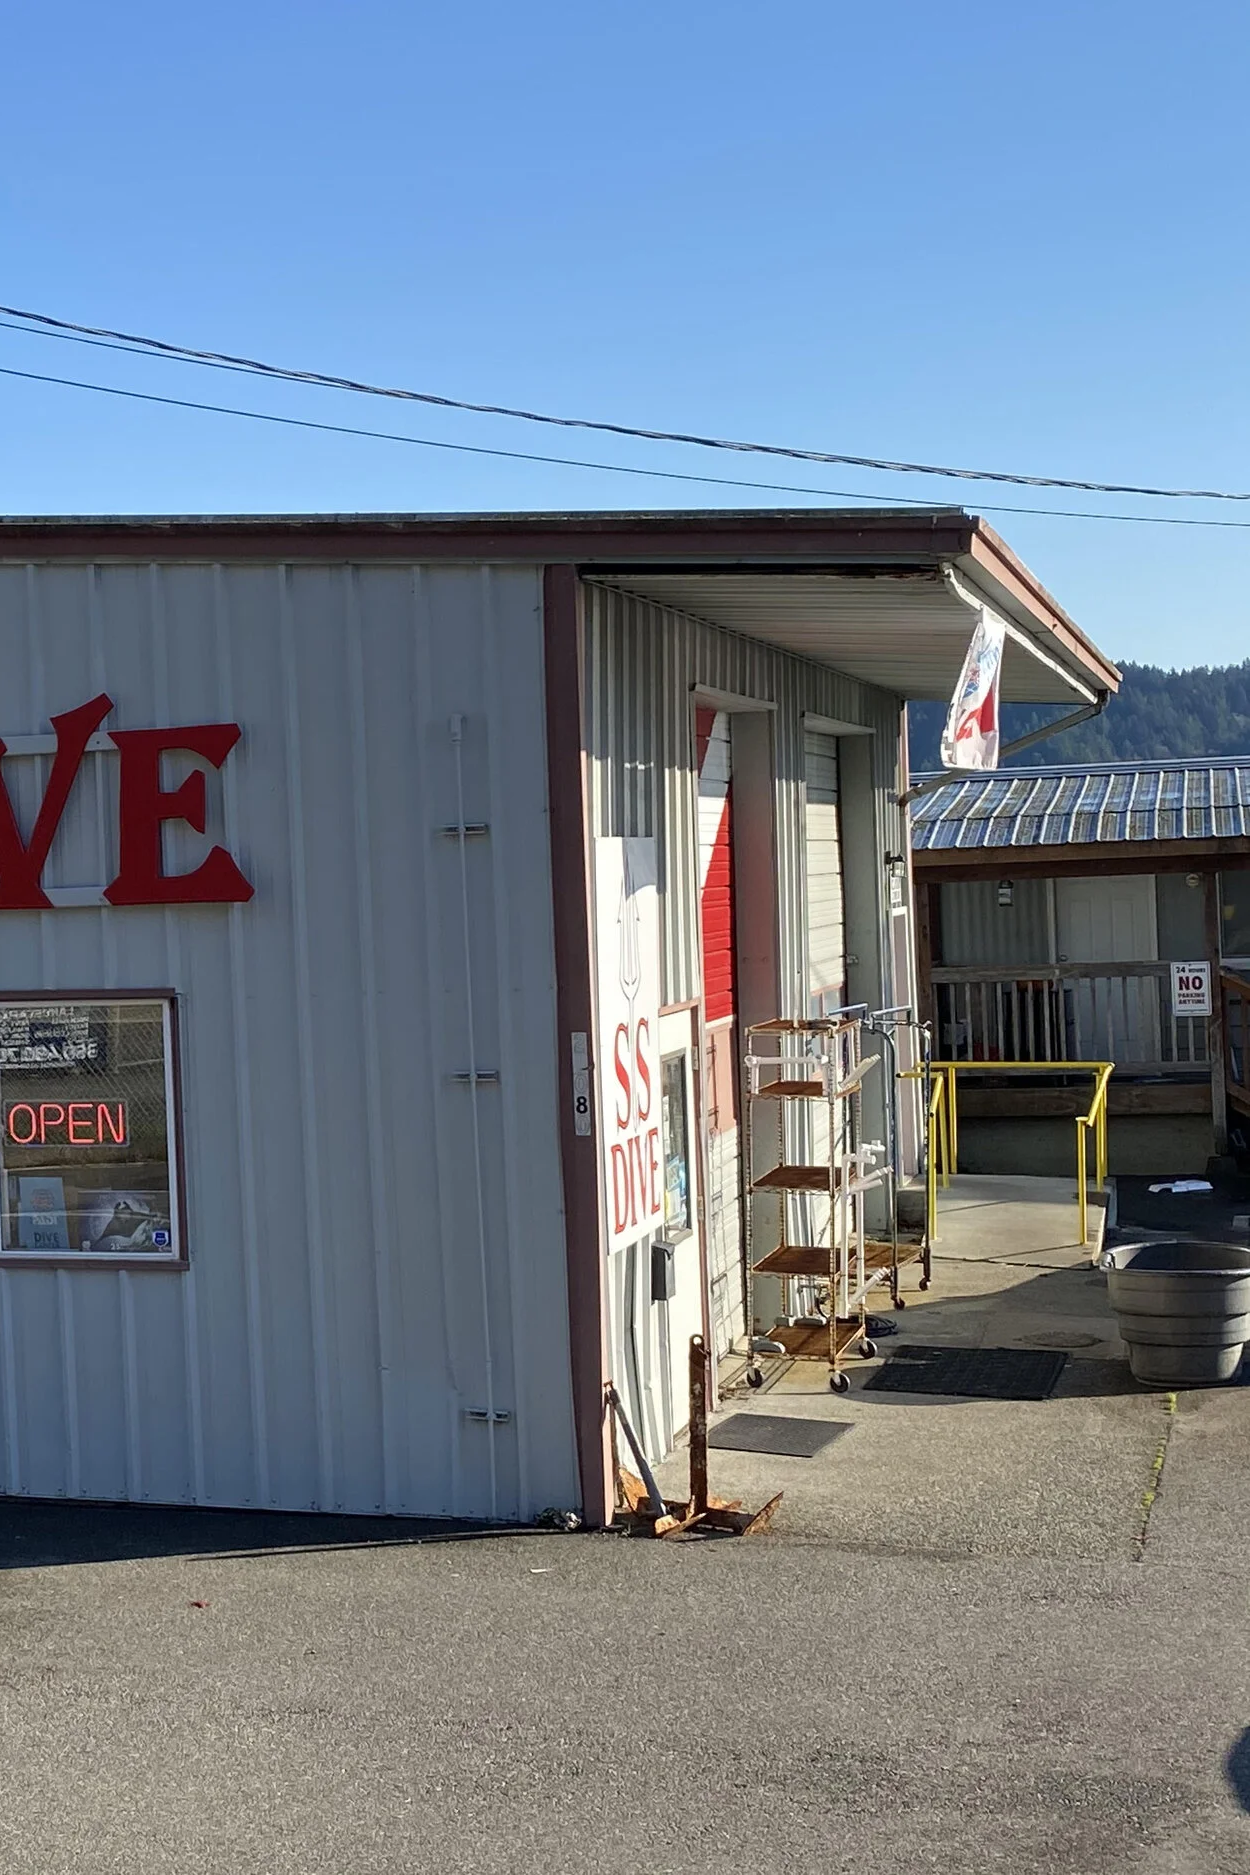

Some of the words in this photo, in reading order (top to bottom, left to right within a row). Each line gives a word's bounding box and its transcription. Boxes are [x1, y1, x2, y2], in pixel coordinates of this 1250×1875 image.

[1175, 966, 1186, 974] 24
[1178, 975, 1204, 991] NO
[7, 1102, 126, 1145] OPEN
[610, 1127, 661, 1235] DIVE
[34, 1231, 60, 1242] DIVE
